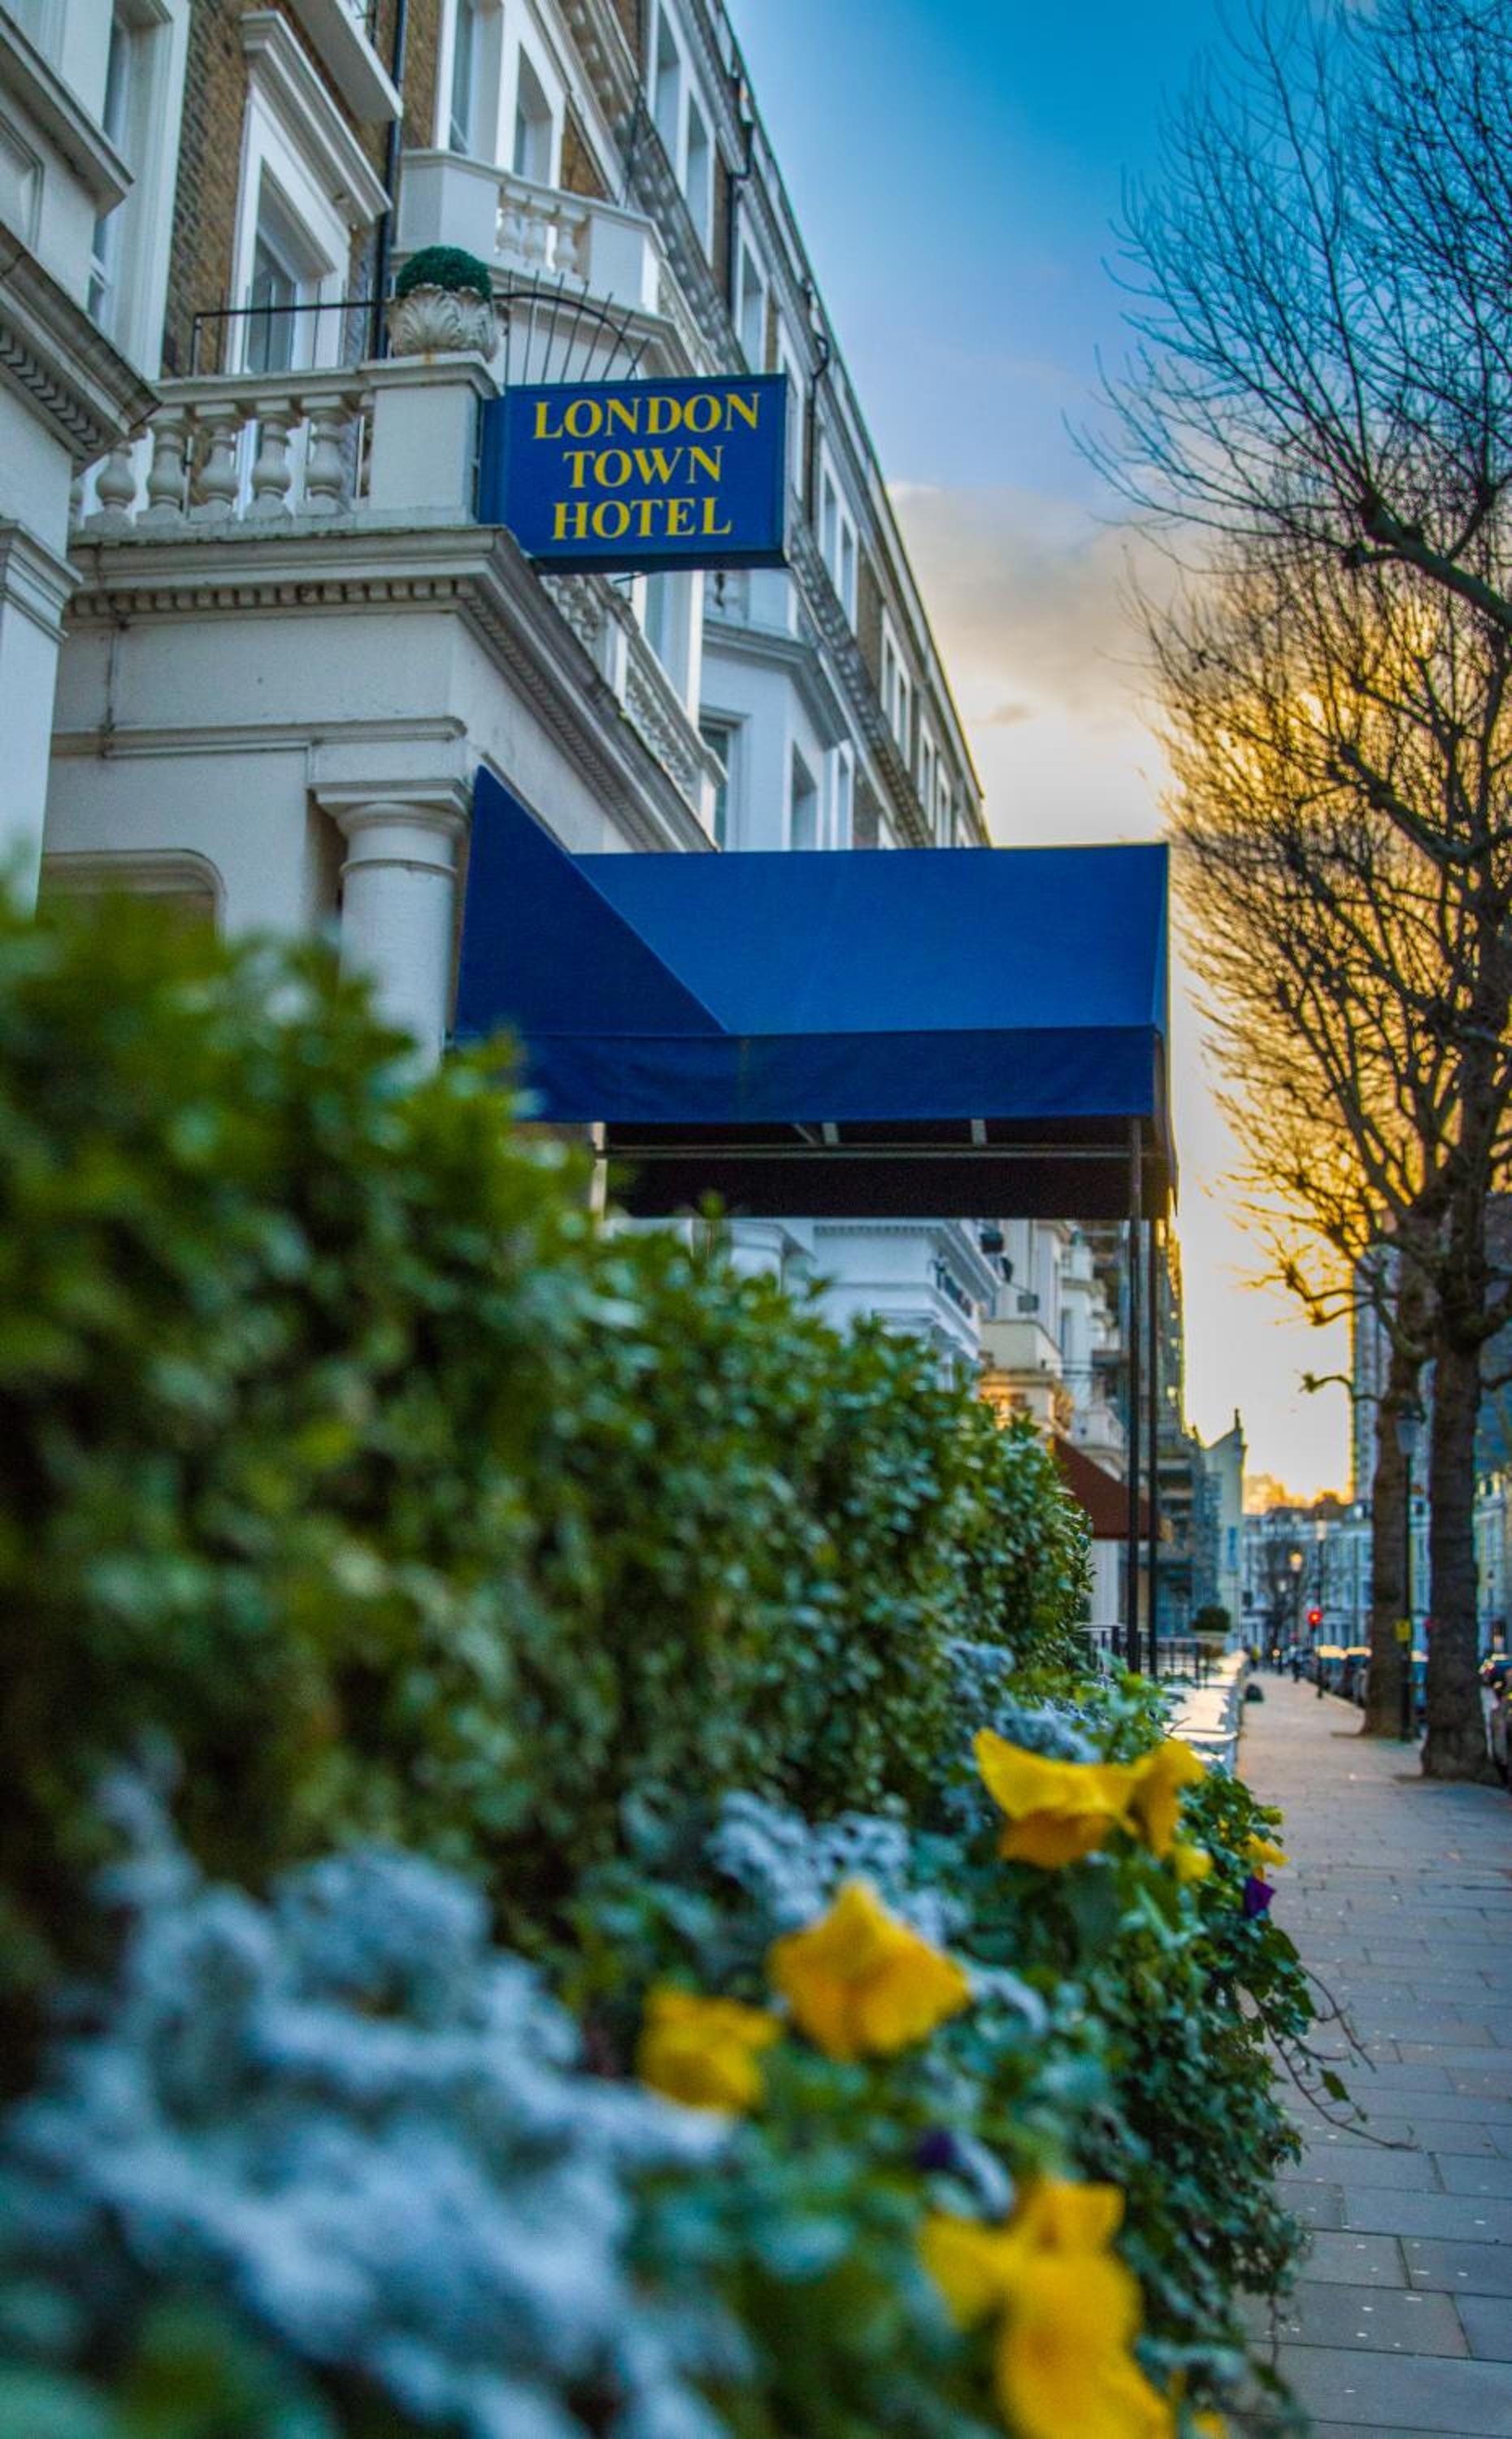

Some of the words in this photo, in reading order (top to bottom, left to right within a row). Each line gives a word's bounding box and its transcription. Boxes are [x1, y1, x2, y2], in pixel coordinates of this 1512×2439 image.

[533, 393, 760, 439] LONDON
[563, 446, 723, 489] TOWN
[551, 497, 732, 540] HOTEL
